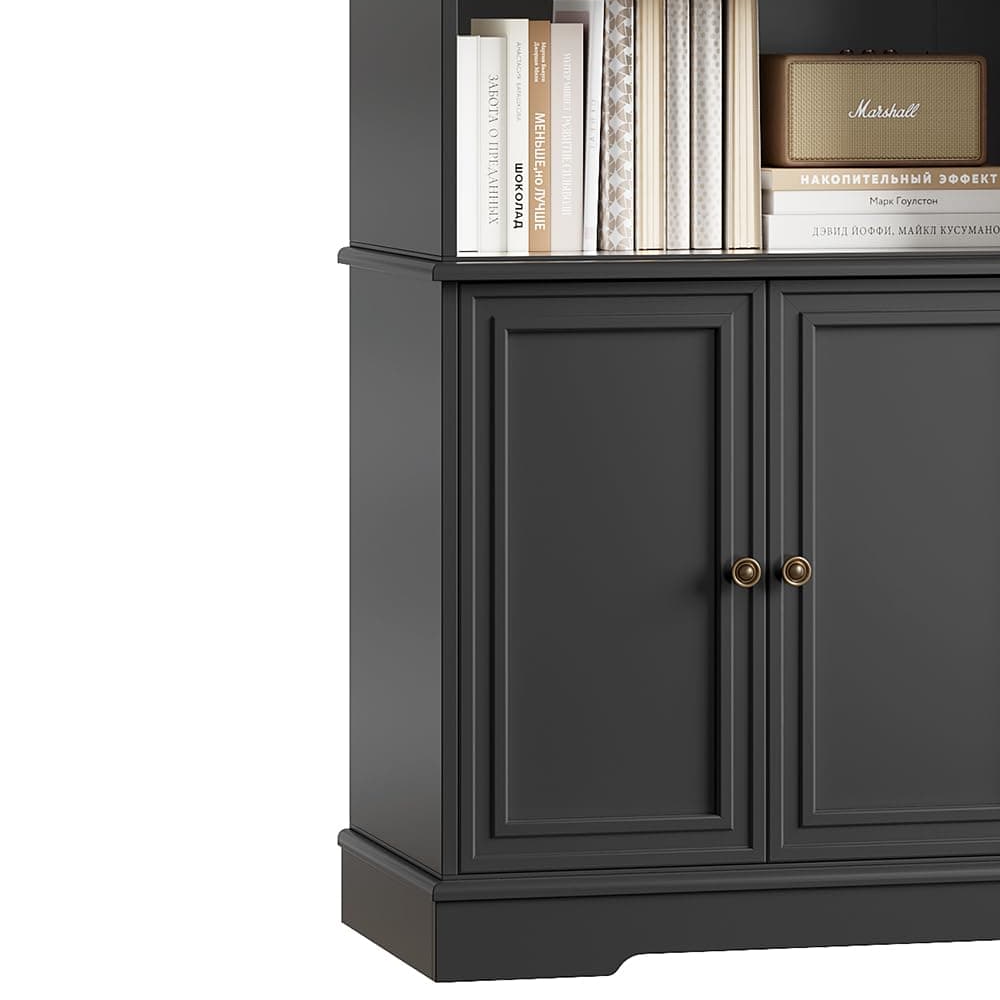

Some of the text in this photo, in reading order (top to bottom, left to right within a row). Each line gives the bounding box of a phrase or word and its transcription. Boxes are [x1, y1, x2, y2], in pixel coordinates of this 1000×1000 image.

[848, 98, 920, 119] Marshall
[488, 73, 500, 225] ЗАБОТА О ПРЕДАННЫХ
[800, 172, 998, 185] НАКОПИТЕЛЬНЫЙ ЭФФЕКТ
[513, 162, 524, 230] ШОКОЛАД
[869, 196, 938, 206] Марк Гоулстон
[534, 187, 546, 231] ЛУЧШЕ
[811, 223, 1000, 237] ДЭВИД ЙОФФИ, МАЙКЛ КУСУМАНО
